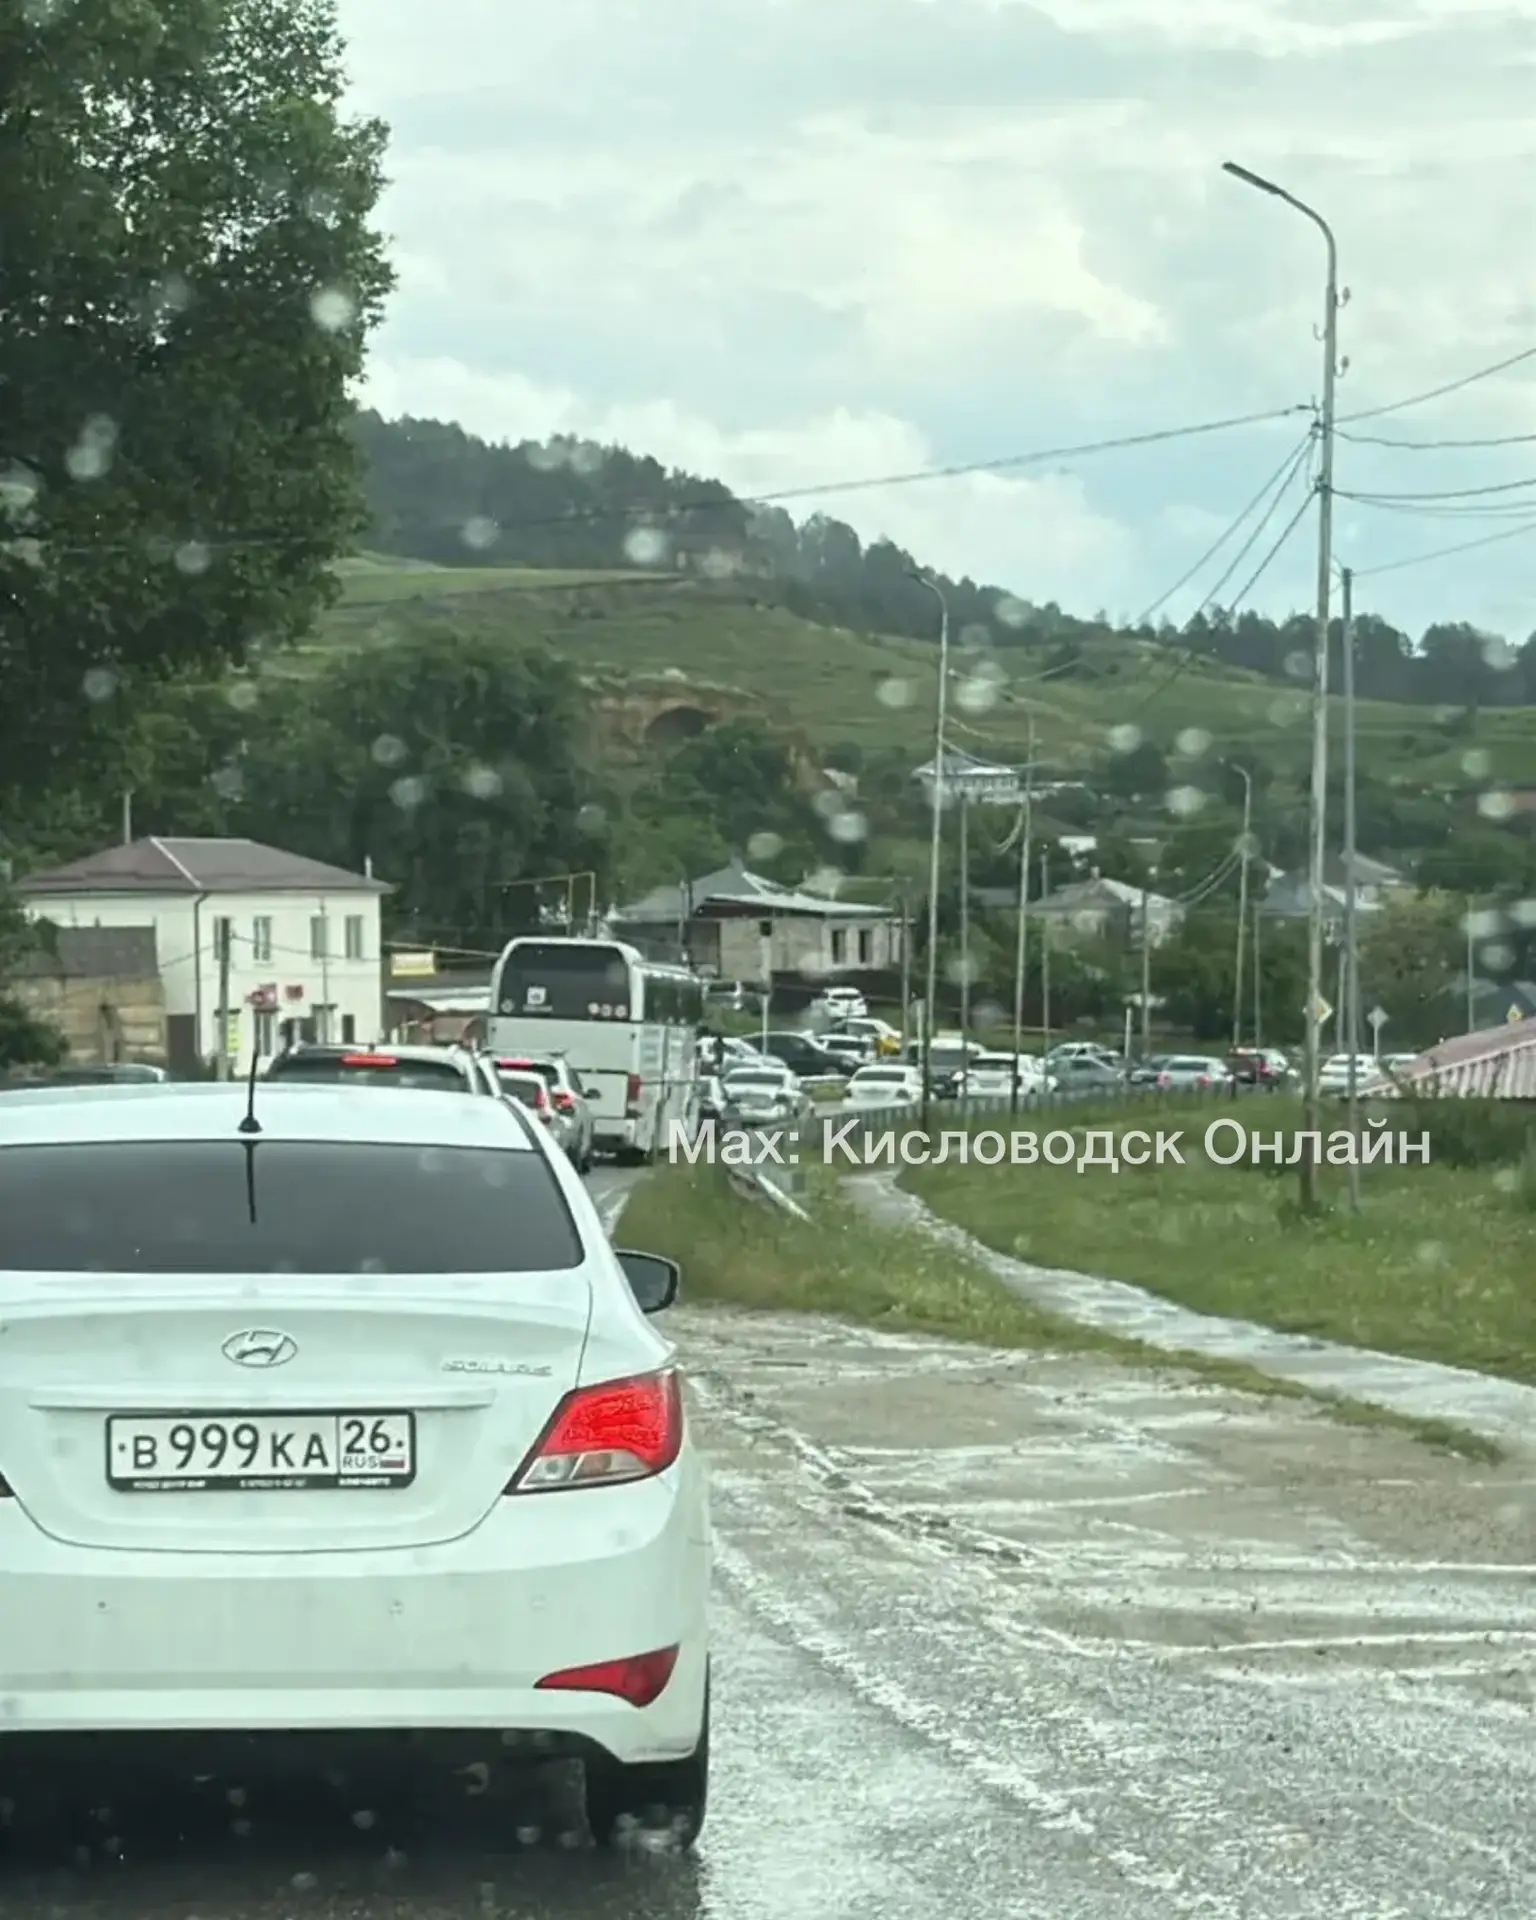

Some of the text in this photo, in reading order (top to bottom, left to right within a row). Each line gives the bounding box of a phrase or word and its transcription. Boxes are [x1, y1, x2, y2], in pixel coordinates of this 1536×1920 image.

[169, 1423, 260, 1470] 999
[344, 1419, 391, 1454] 26
[343, 1455, 379, 1469] RUS
